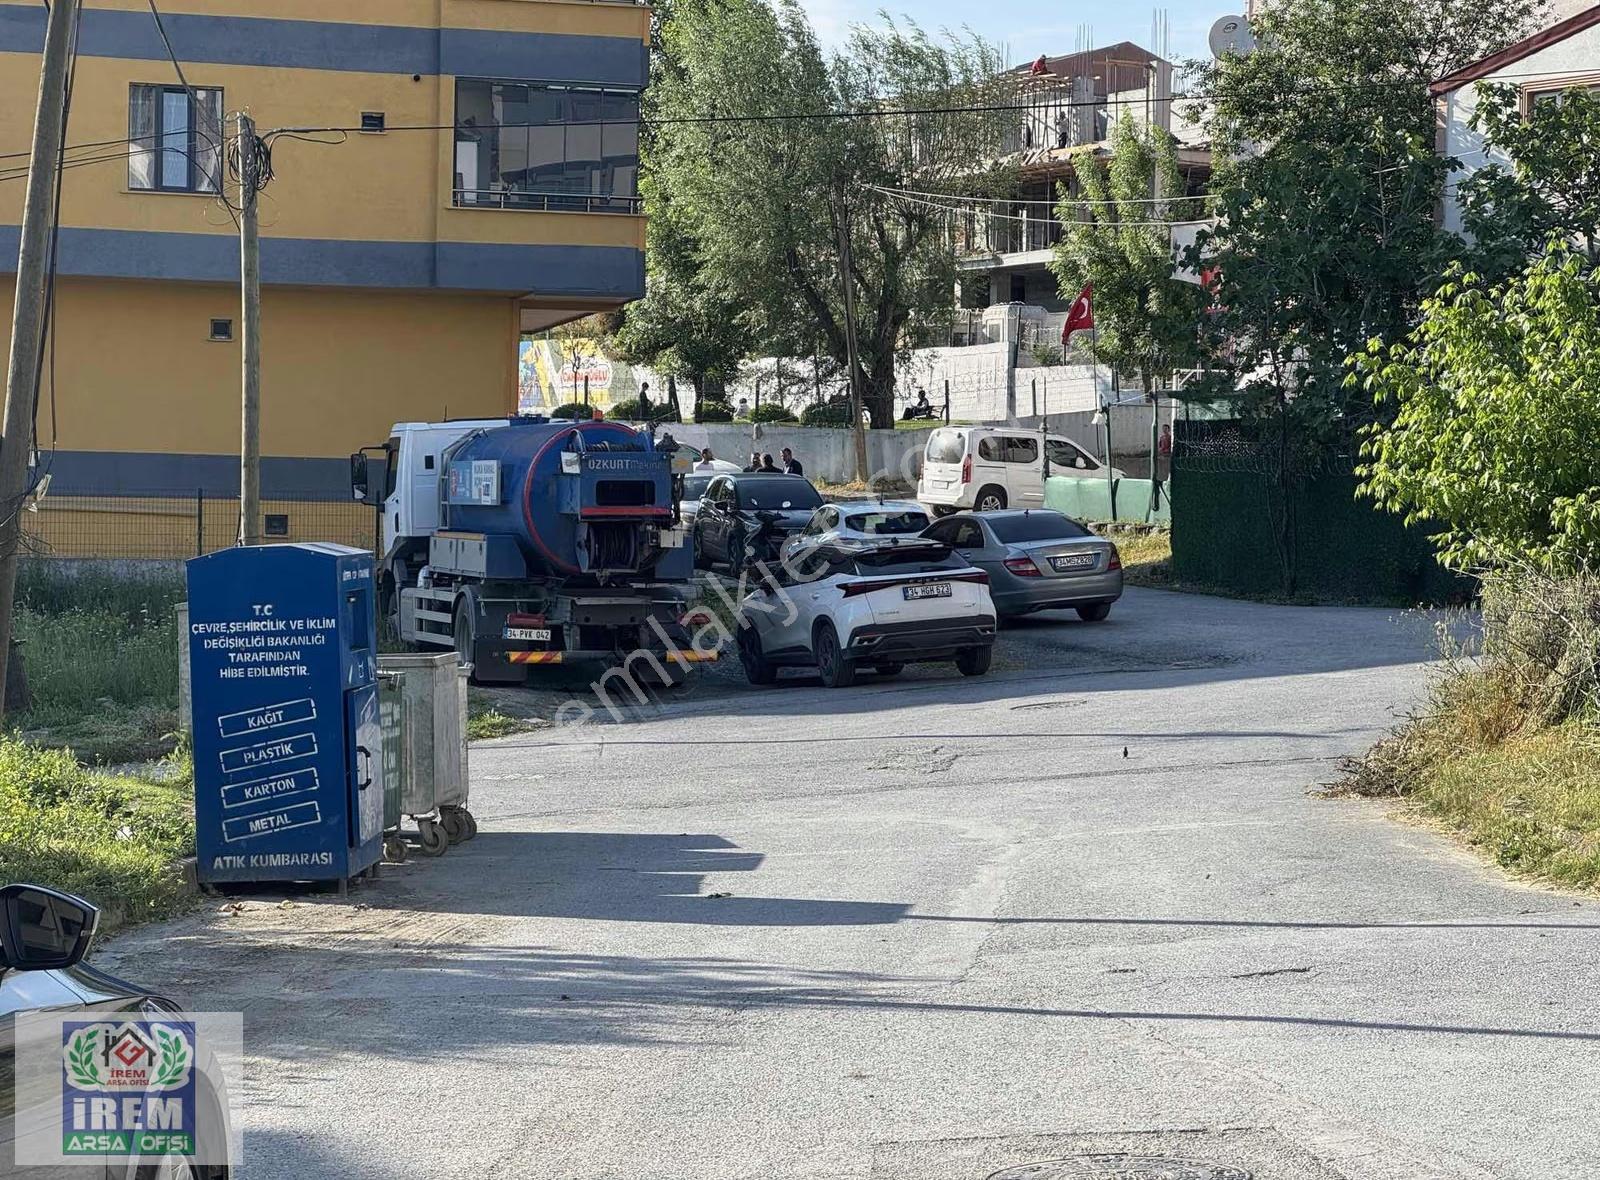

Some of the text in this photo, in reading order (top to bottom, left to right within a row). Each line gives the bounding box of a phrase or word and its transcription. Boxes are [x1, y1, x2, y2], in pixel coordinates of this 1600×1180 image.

[253, 604, 273, 616] T.C
[290, 619, 304, 630] VE
[306, 617, 336, 629] İKLİM
[204, 633, 325, 649] DEĞİŞİKLİĞİ BAKANLIĞI
[520, 630, 533, 639] PVK
[536, 631, 549, 640] 042
[228, 651, 301, 663] TARAFINDAN
[220, 665, 310, 678] HİBE EDİLMİŞTİR.
[247, 710, 284, 728] KAĞIT
[243, 743, 294, 763] PLASTİK
[244, 778, 296, 799] KARTON
[249, 813, 292, 832] METAL
[213, 852, 333, 869] ATIK KUMBARASI
